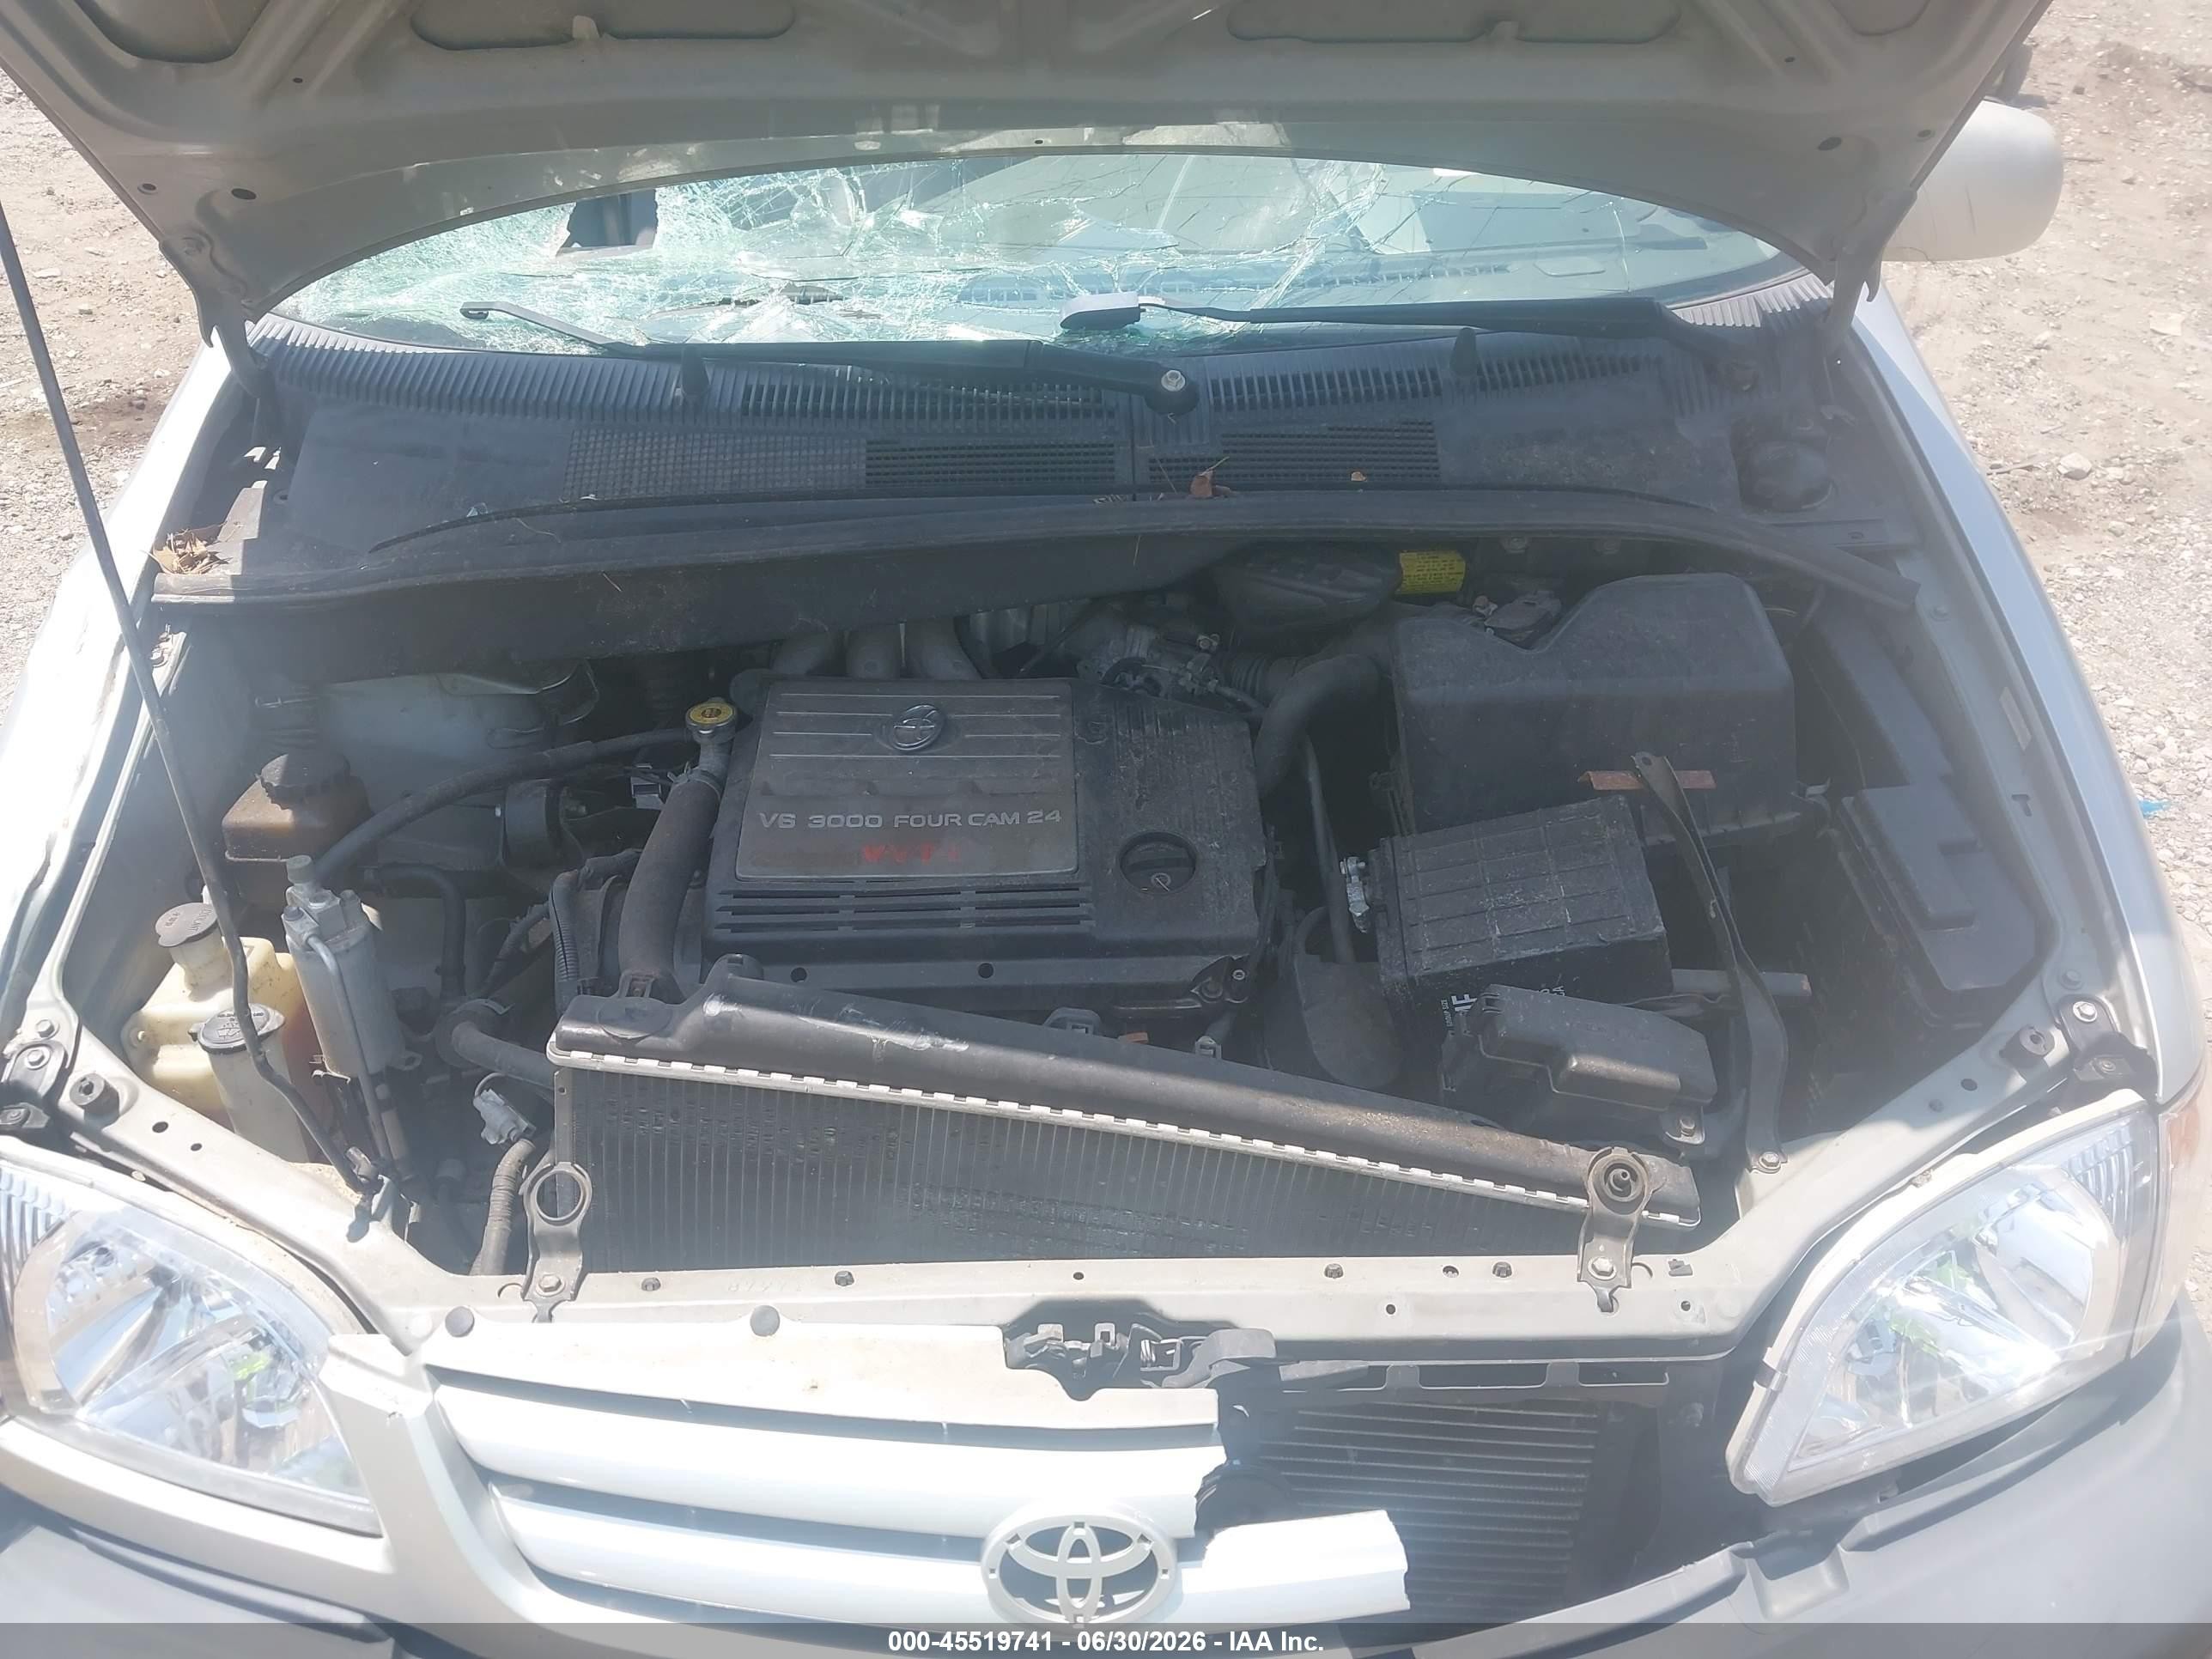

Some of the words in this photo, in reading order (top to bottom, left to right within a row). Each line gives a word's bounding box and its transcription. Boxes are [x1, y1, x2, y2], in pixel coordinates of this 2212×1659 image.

[759, 812, 796, 829] V6
[807, 814, 883, 829] 3000
[894, 814, 963, 828] FOUR
[968, 811, 1020, 826] CAM
[1026, 809, 1062, 824] 24
